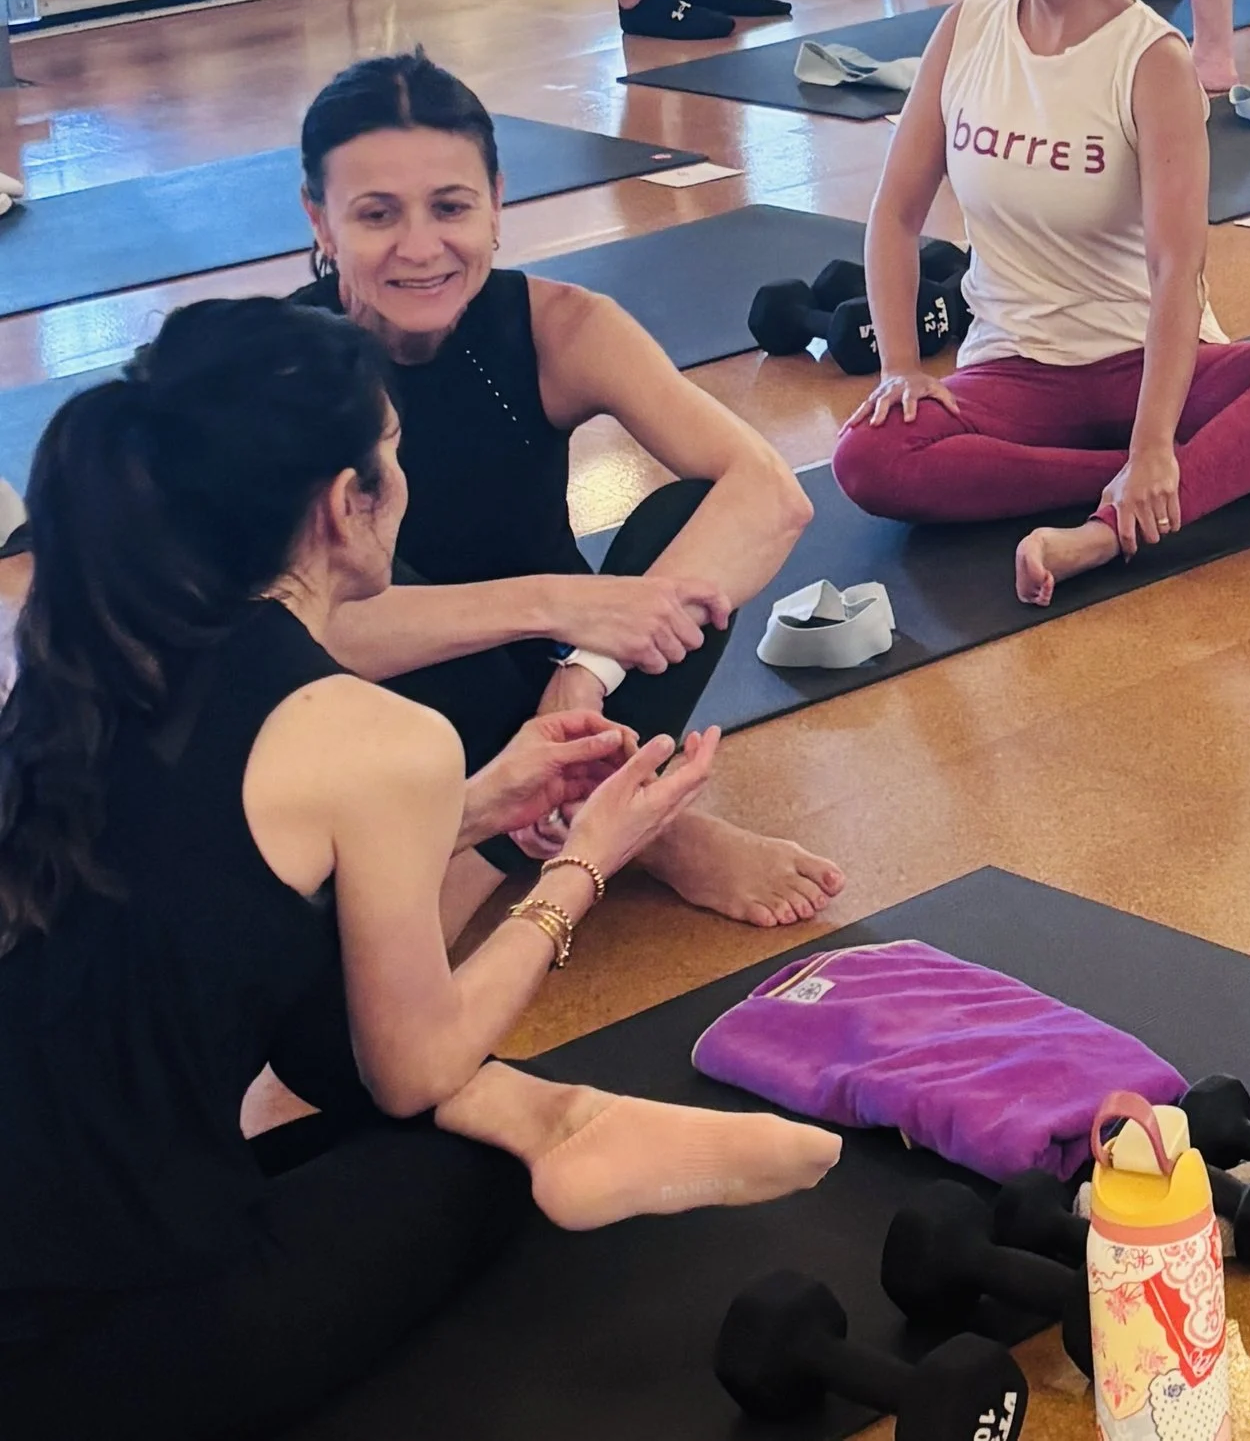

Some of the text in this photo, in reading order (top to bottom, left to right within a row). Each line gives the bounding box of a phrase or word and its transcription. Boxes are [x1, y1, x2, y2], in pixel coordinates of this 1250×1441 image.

[924, 312, 937, 333] 12
[973, 1408, 996, 1441] 10
[990, 1391, 1018, 1441] VT
